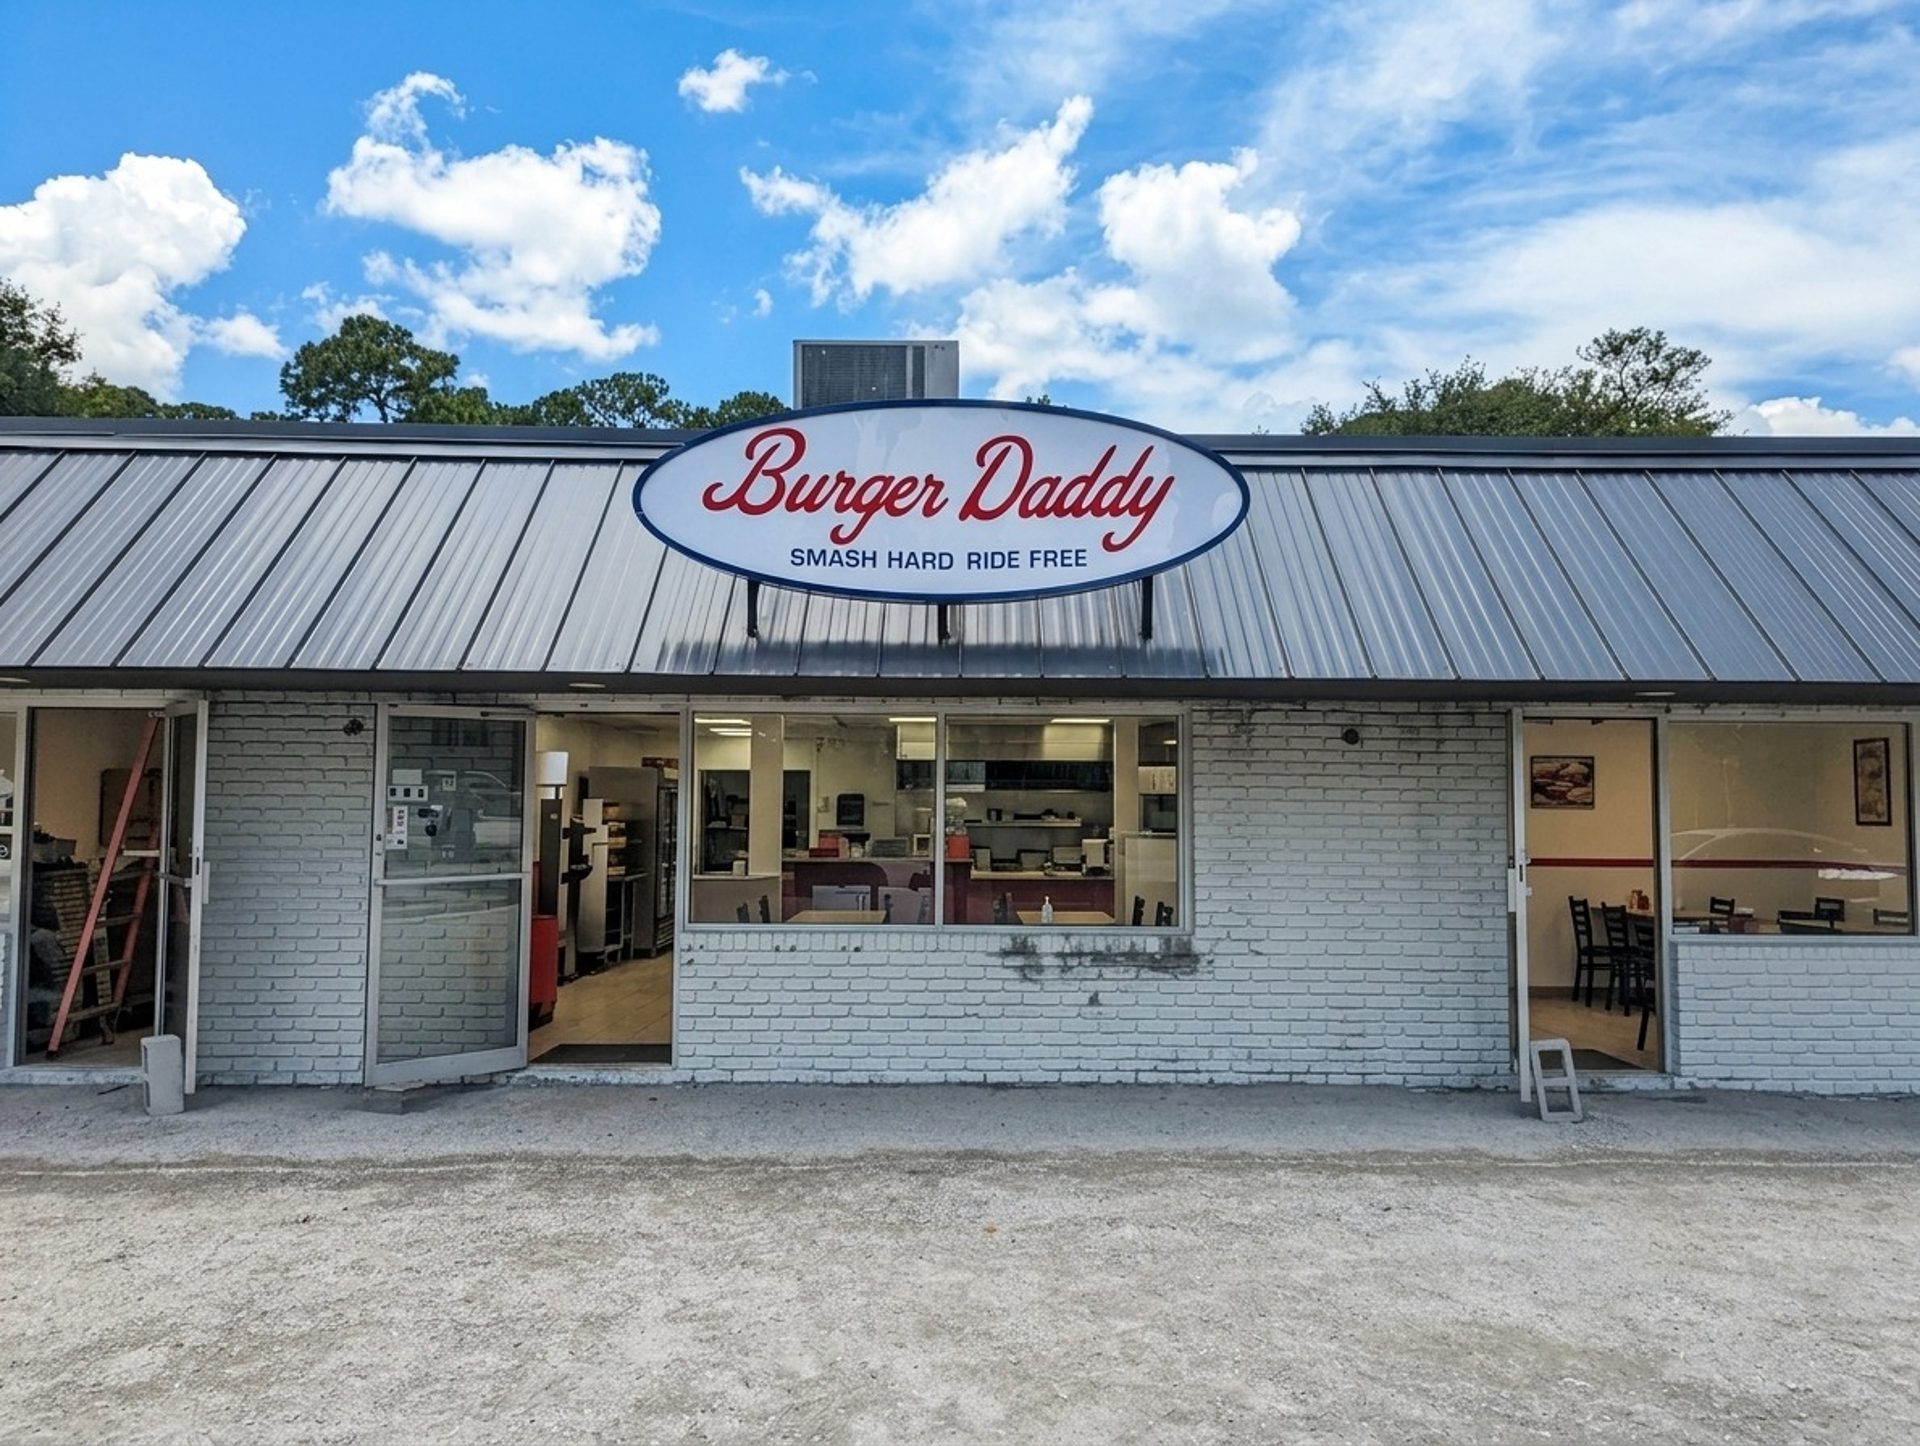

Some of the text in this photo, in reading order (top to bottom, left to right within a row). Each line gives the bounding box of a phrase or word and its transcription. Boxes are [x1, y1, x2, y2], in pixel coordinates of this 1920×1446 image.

[702, 427, 1175, 553] Burger Daddy
[790, 547, 1088, 571] SMASH HARD RIDE FREE
